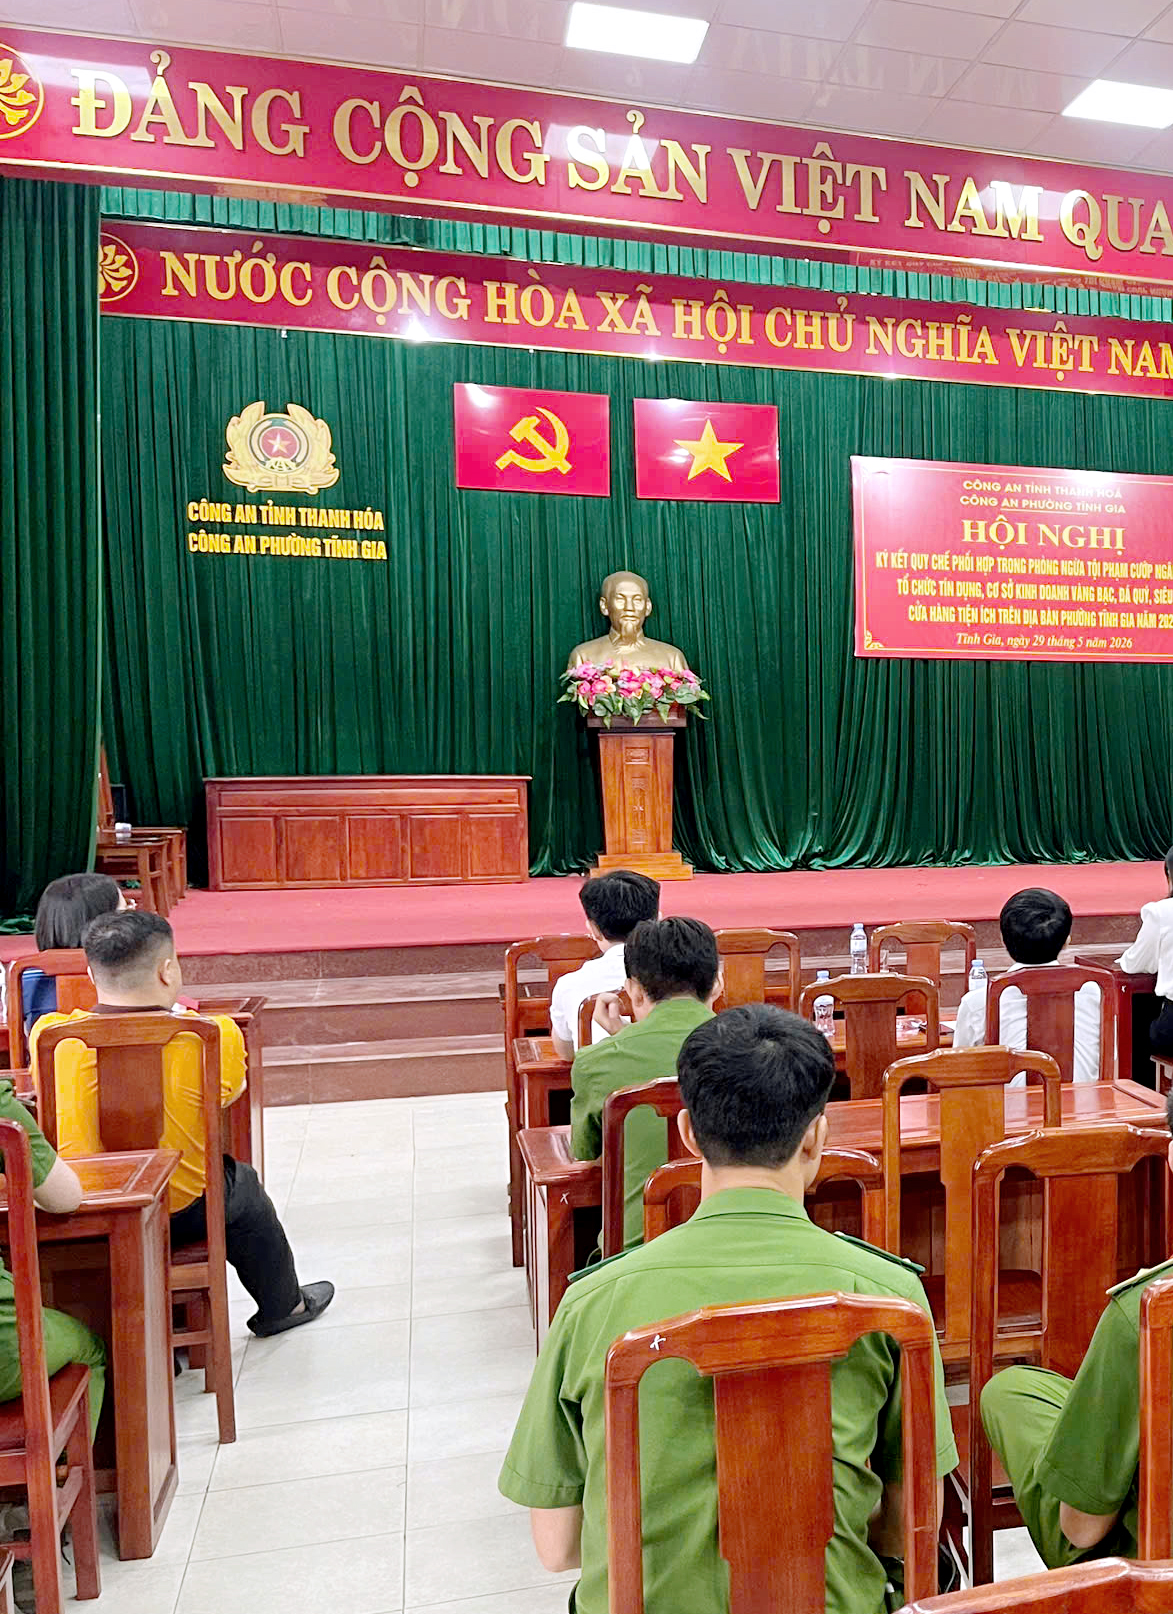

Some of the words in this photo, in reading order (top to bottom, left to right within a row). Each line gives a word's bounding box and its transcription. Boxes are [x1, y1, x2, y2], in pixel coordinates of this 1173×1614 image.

[71, 50, 310, 158] ĐẢNG
[333, 85, 550, 188] CỘNG
[567, 109, 710, 203] SẢN
[727, 142, 886, 233] VIỆT
[904, 170, 1044, 243] NAM
[160, 242, 313, 308] NƯỚC
[326, 261, 472, 326] CỘNG
[483, 268, 587, 331] HÒA
[596, 284, 661, 337] XÃ
[671, 289, 753, 354] HỘI
[764, 297, 857, 352] CHỦ
[866, 315, 998, 366] NGHĨA
[1006, 321, 1099, 381] VIỆT
[960, 494, 998, 506] CÔNG
[1002, 499, 1018, 508] AN
[1022, 498, 1072, 510] PHƯỜNG
[1076, 501, 1101, 512] TĨNH
[1105, 504, 1126, 513] GIA
[963, 479, 1001, 491] CÔNG
[1005, 483, 1022, 493] AN
[1025, 481, 1051, 495] TỈNH
[187, 497, 232, 523] CÔNG
[234, 504, 257, 524] AN
[259, 499, 296, 526] TỈNH
[298, 507, 351, 529] THANH
[352, 506, 385, 531] HÓA
[188, 529, 231, 553] CÔNG
[233, 535, 257, 555] AN
[259, 532, 322, 557] PHƯỜNG
[323, 535, 358, 559] TĨNH
[360, 540, 388, 560] GIA
[961, 515, 1028, 550] HỘI
[1037, 523, 1126, 556] NGHỊ
[876, 549, 889, 568] KÝ
[891, 547, 909, 569] KẾT
[911, 553, 929, 571] QUY
[932, 550, 950, 571] CHẾ
[952, 550, 974, 572] PHỐI
[976, 555, 995, 576] HỢP
[997, 557, 1027, 574] TRONG
[1028, 555, 1059, 575] PHÒNG
[1061, 558, 1085, 577] NGỪA
[1087, 559, 1101, 580] TỘI
[1103, 562, 1128, 581] PHẠM
[1130, 560, 1153, 579] CƯỚP
[897, 573, 909, 595] TỔ
[912, 577, 936, 596] CHỨC
[939, 577, 954, 596] TÍN
[956, 582, 985, 601] DỤNG,
[986, 582, 999, 598] CƠ
[1001, 578, 1014, 599] SỞ
[1016, 584, 1037, 600] KINH
[1039, 585, 1069, 601] DOANH
[1072, 583, 1095, 602] VÀNG
[1097, 587, 1117, 606] BẠC,
[1154, 586, 1173, 605] SIÊU
[908, 600, 928, 622] CỬA
[930, 602, 955, 622] HÀNG
[958, 605, 978, 627] TIỆN
[980, 604, 996, 624] ÍCH
[998, 606, 1021, 624] TRÊN
[1040, 607, 1058, 626] BÀN
[1061, 607, 1096, 627] PHƯỜNG
[1098, 609, 1119, 628] TĨNH
[1120, 613, 1135, 628] GIA
[1136, 610, 1157, 628] NĂM
[956, 633, 981, 645] Tĩnh
[1007, 635, 1030, 648] ngày
[1033, 635, 1045, 645] 29
[1047, 635, 1075, 650] tháng
[1077, 637, 1084, 647] 5
[1086, 637, 1107, 648] năm
[1110, 637, 1133, 648] 2026
